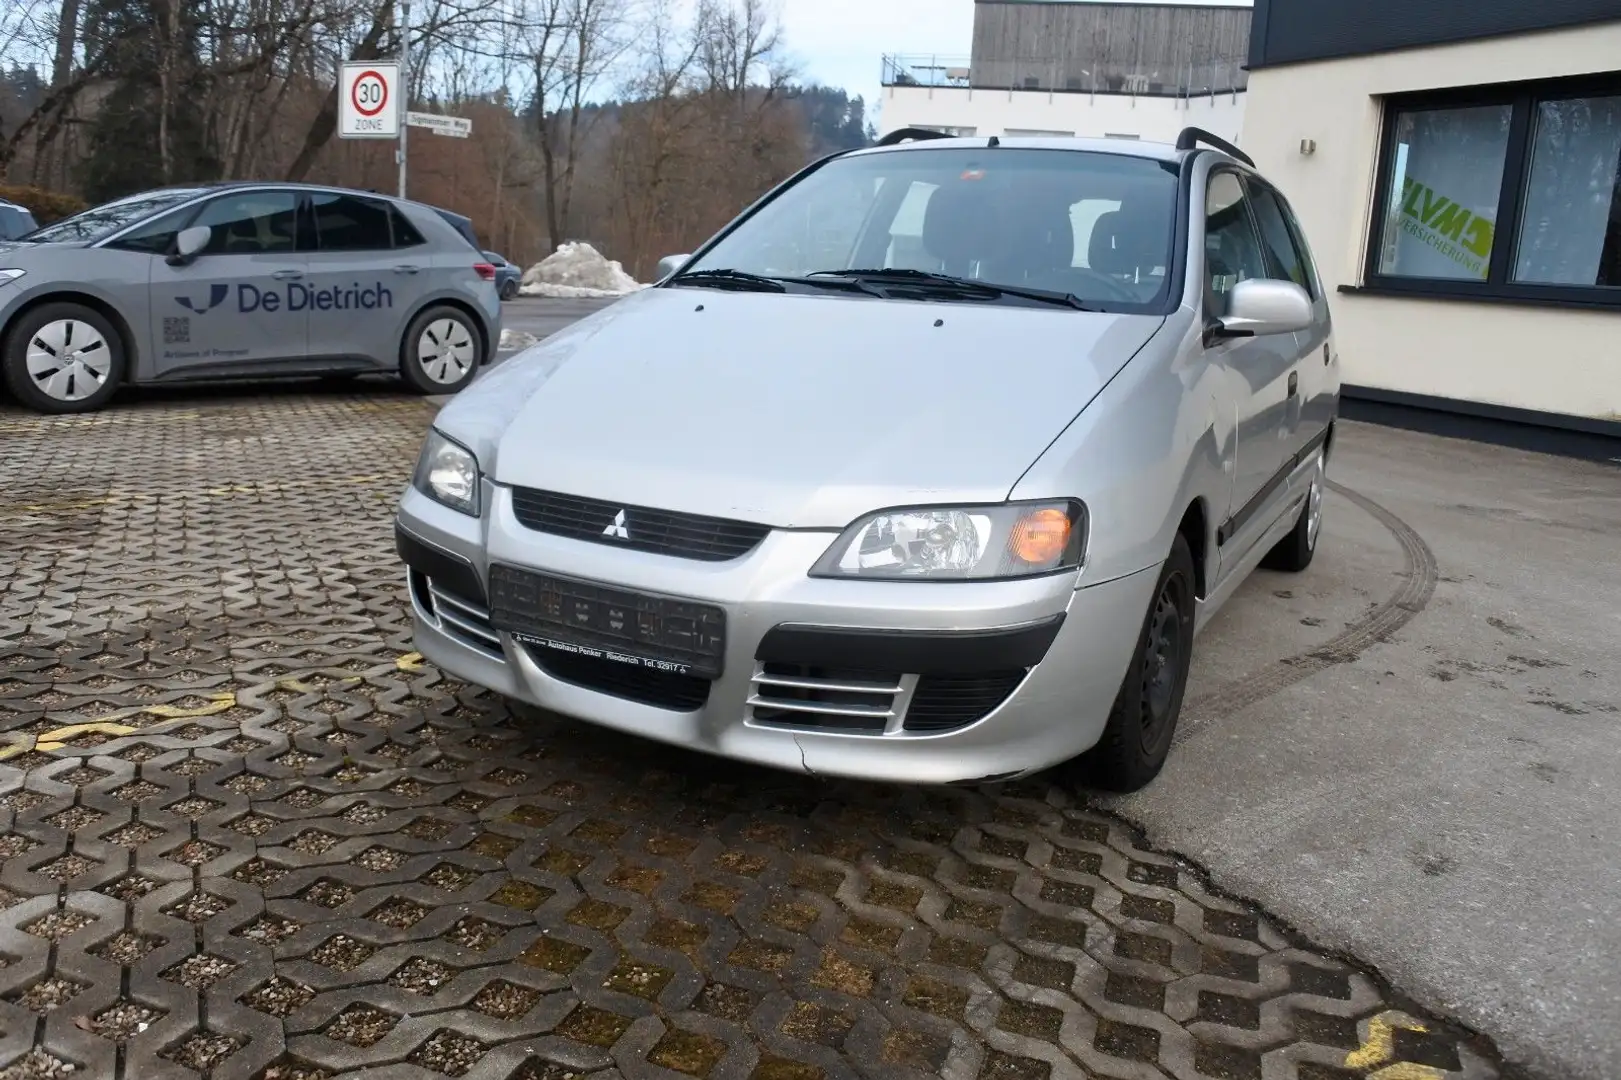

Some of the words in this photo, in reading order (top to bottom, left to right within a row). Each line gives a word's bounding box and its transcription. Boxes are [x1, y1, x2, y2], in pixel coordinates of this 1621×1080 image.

[359, 83, 380, 103] 30
[355, 119, 383, 130] ZONE
[237, 283, 281, 313] De
[287, 281, 393, 311] Dietrich
[548, 640, 578, 653] Autohaus
[578, 646, 602, 658] Penker
[606, 652, 639, 665] Riederich
[643, 658, 656, 668] Tel.
